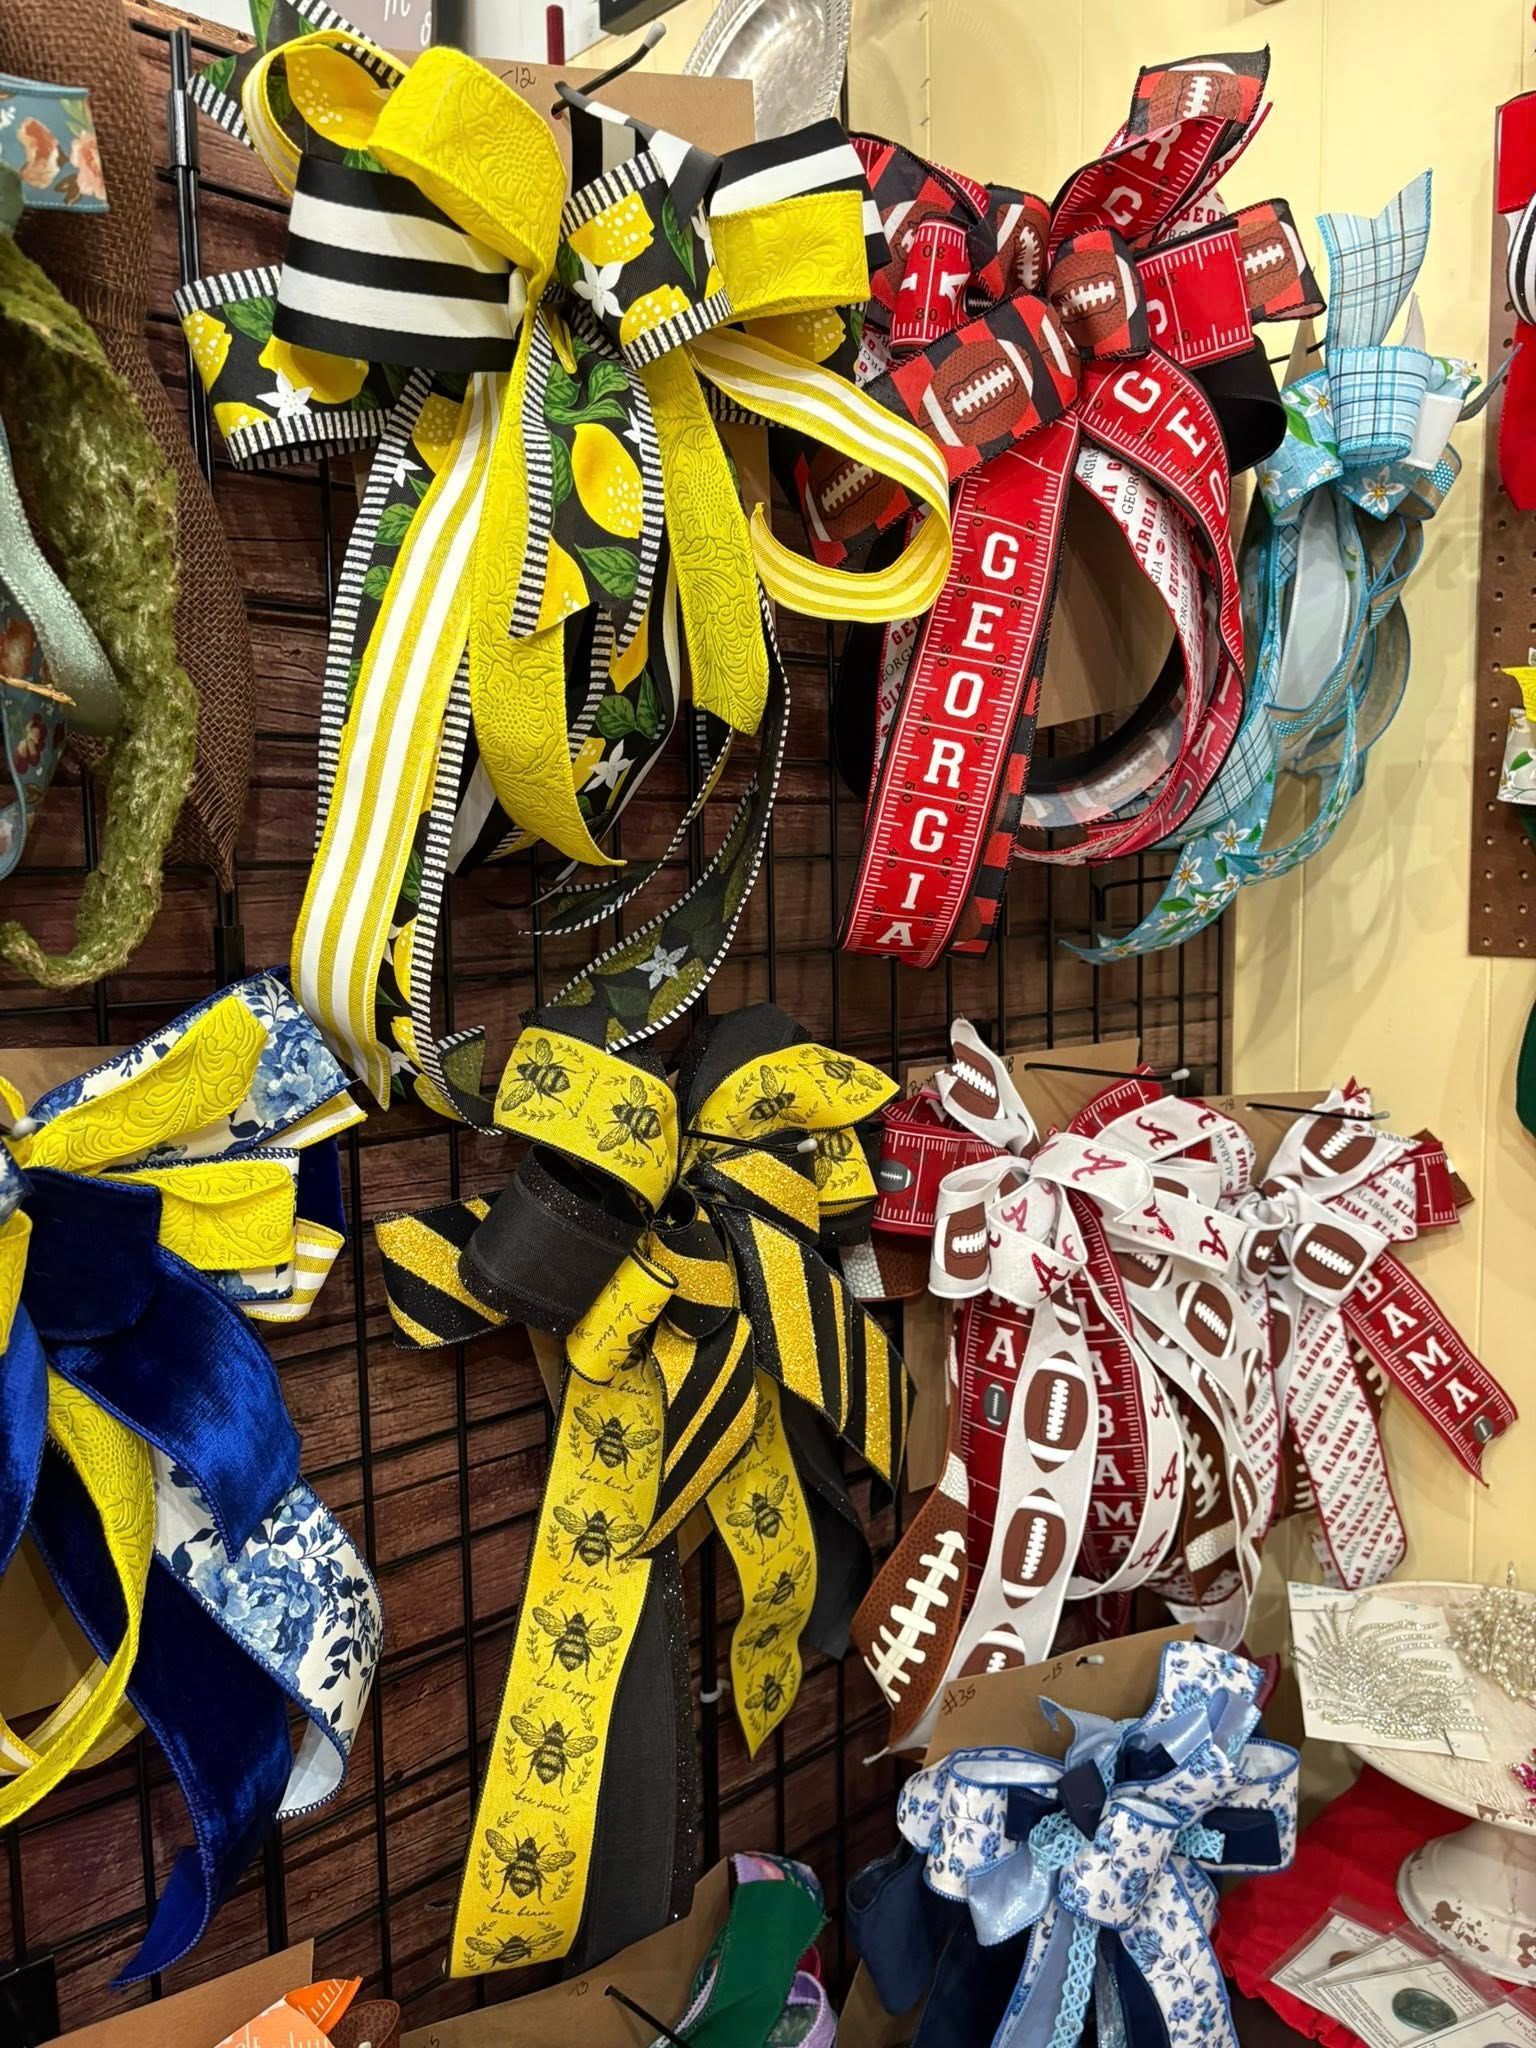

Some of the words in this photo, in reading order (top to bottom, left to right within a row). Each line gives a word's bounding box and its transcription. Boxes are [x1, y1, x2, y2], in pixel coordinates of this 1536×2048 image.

[876, 531, 1020, 947] GEORGIA
[559, 1570, 585, 1585] bee
[532, 1674, 558, 1690] bee
[512, 1788, 537, 1804] bee
[487, 1901, 514, 1915] bee
